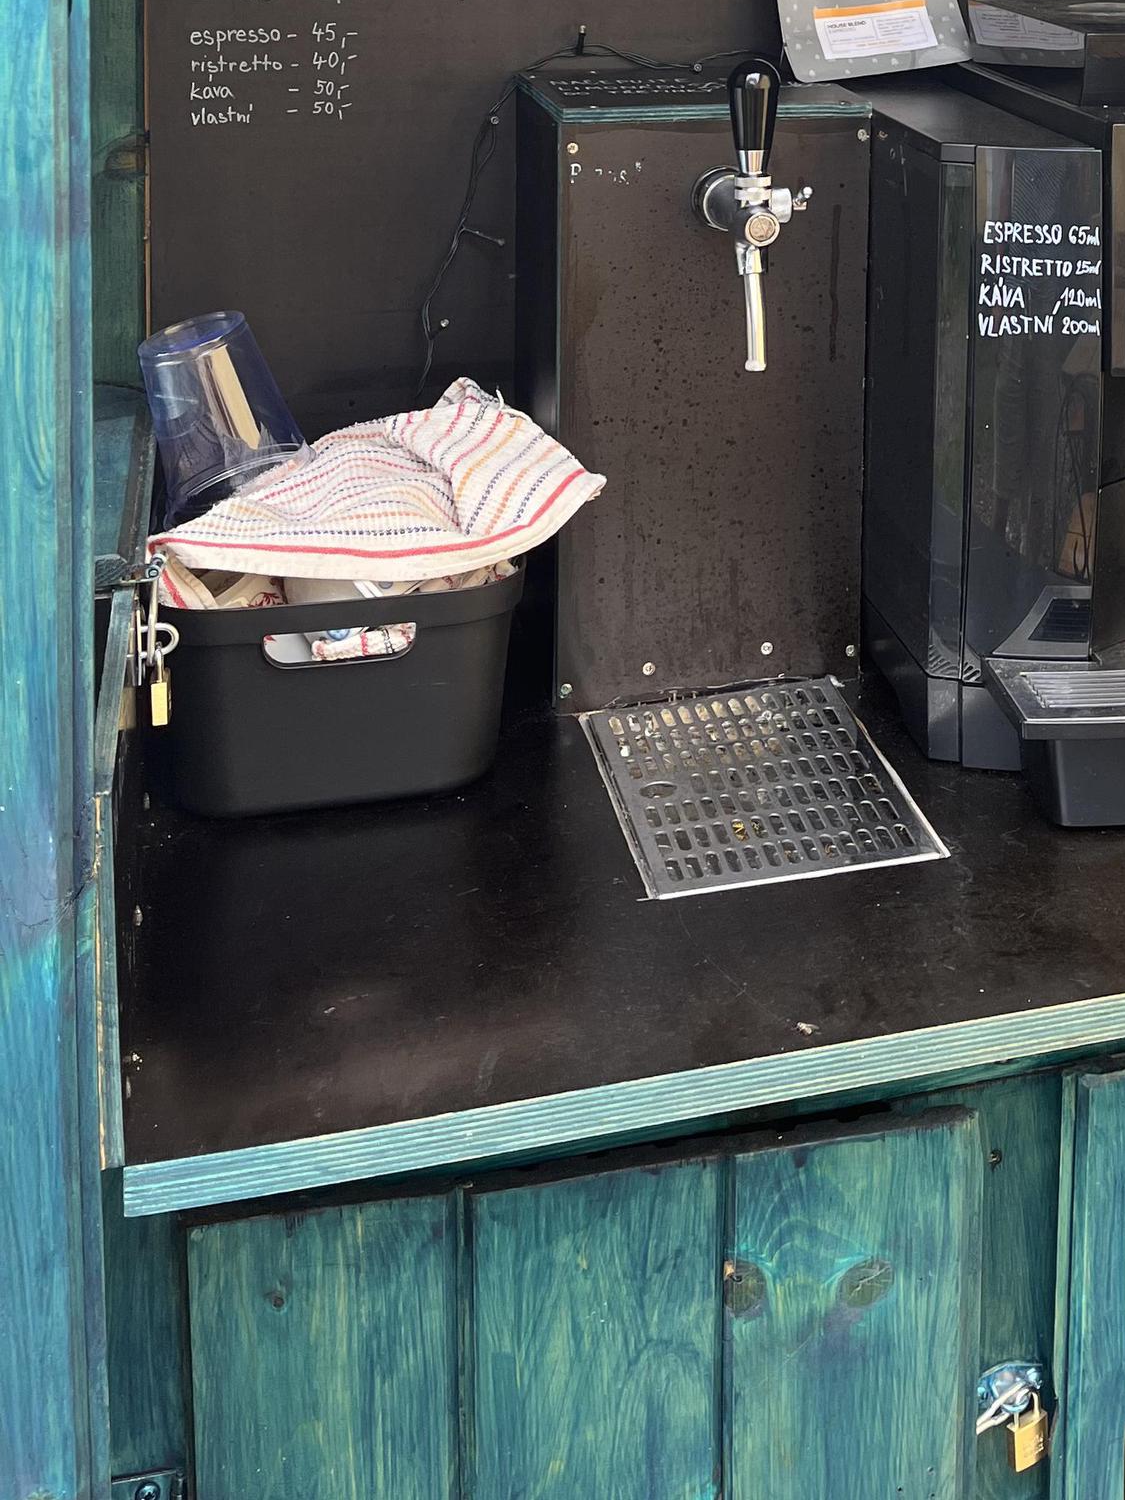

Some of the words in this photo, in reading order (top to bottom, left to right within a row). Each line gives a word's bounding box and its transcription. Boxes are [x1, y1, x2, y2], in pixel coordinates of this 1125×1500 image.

[190, 27, 281, 52] espresso
[191, 54, 283, 74] ristretto
[190, 74, 236, 100] káva
[190, 103, 254, 126] vlastní
[983, 220, 1063, 245] ESPRESSO
[980, 253, 1073, 278] RISTRETTO
[978, 276, 1025, 309] KÁVA
[978, 300, 1061, 338] VLASTNÍ
[1061, 316, 1101, 337] 200ml
